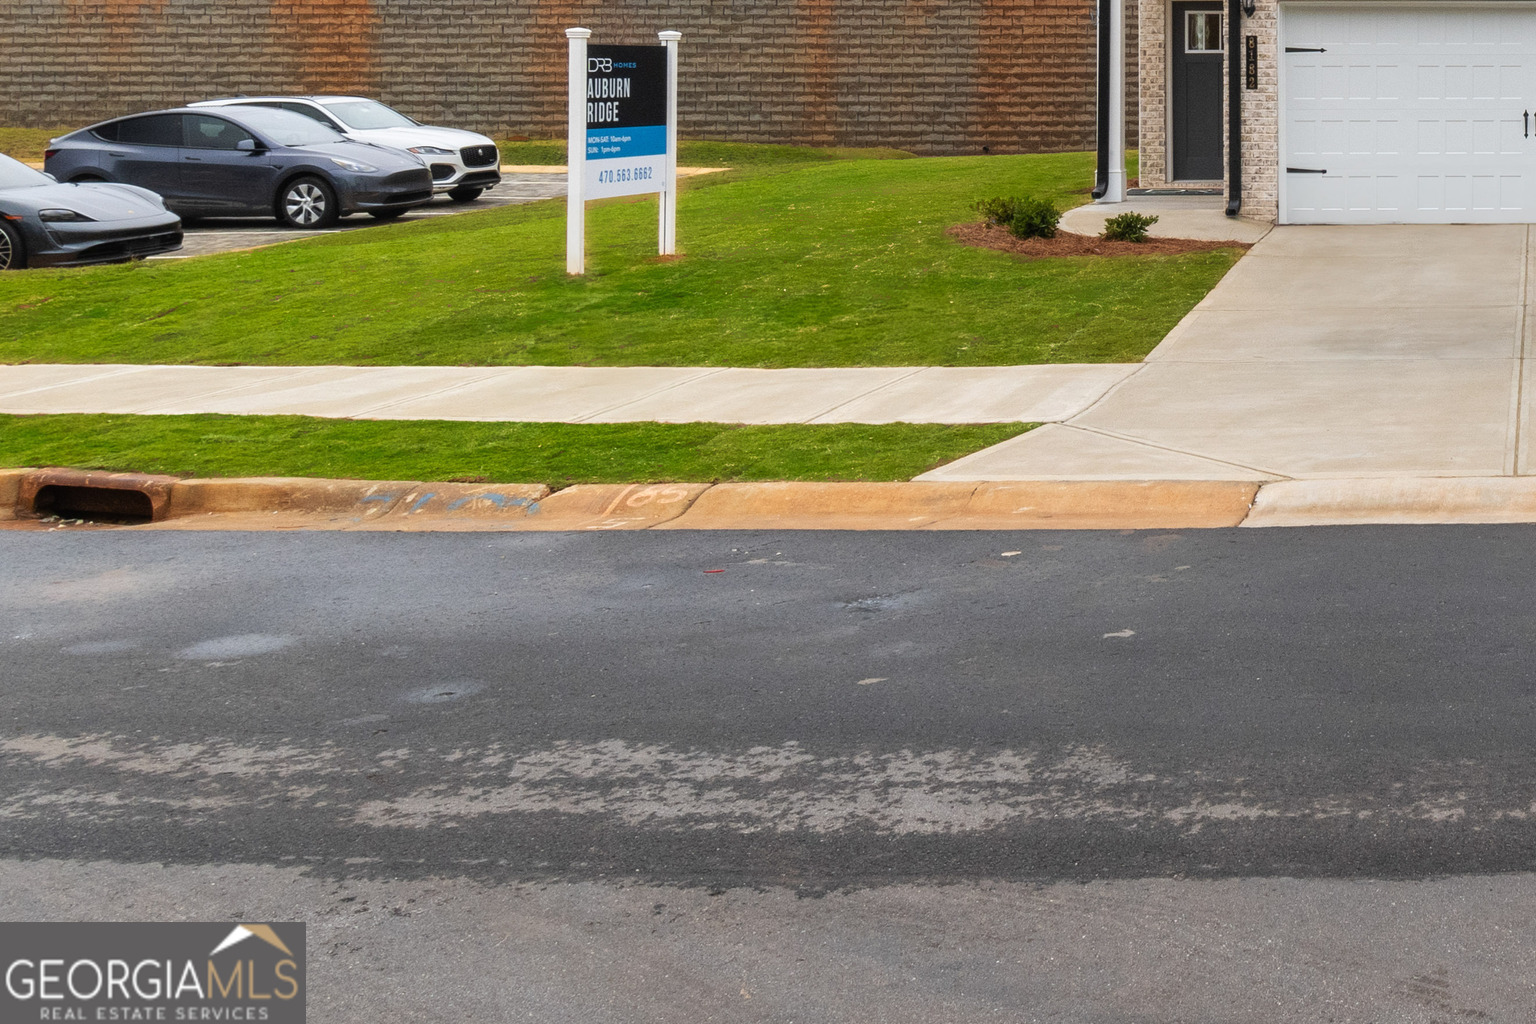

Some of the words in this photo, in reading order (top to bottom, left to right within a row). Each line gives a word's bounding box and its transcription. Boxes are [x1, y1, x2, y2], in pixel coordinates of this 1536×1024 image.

[588, 57, 612, 73] DRB
[587, 77, 631, 99] AUBURN
[587, 101, 620, 123] RIDGE
[598, 166, 653, 184] 470.563.6662
